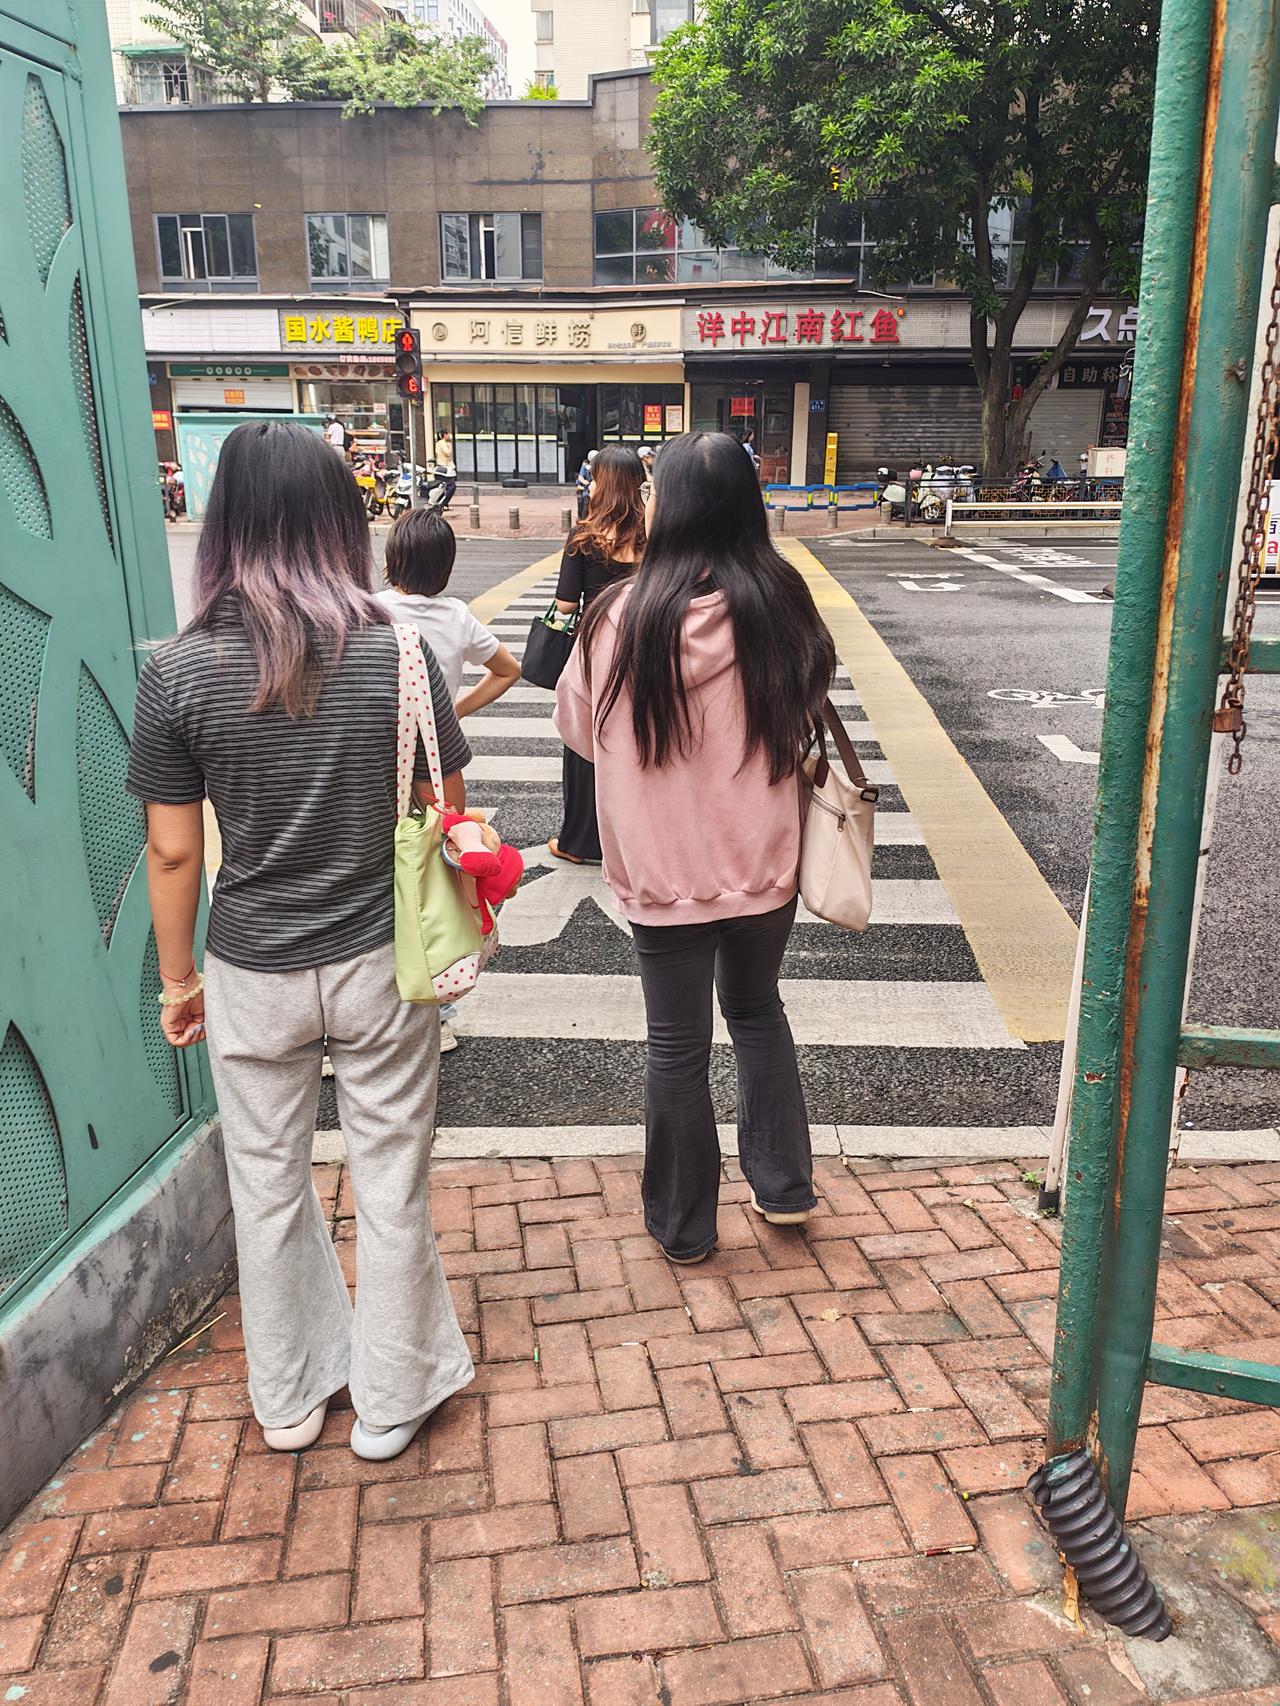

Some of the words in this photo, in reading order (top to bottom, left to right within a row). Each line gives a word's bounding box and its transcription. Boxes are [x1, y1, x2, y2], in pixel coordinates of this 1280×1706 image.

[285, 315, 402, 343] 国水酱鸭店
[469, 319, 592, 347] 阿信鲜捞
[697, 308, 899, 347] 洋中江南红鱼
